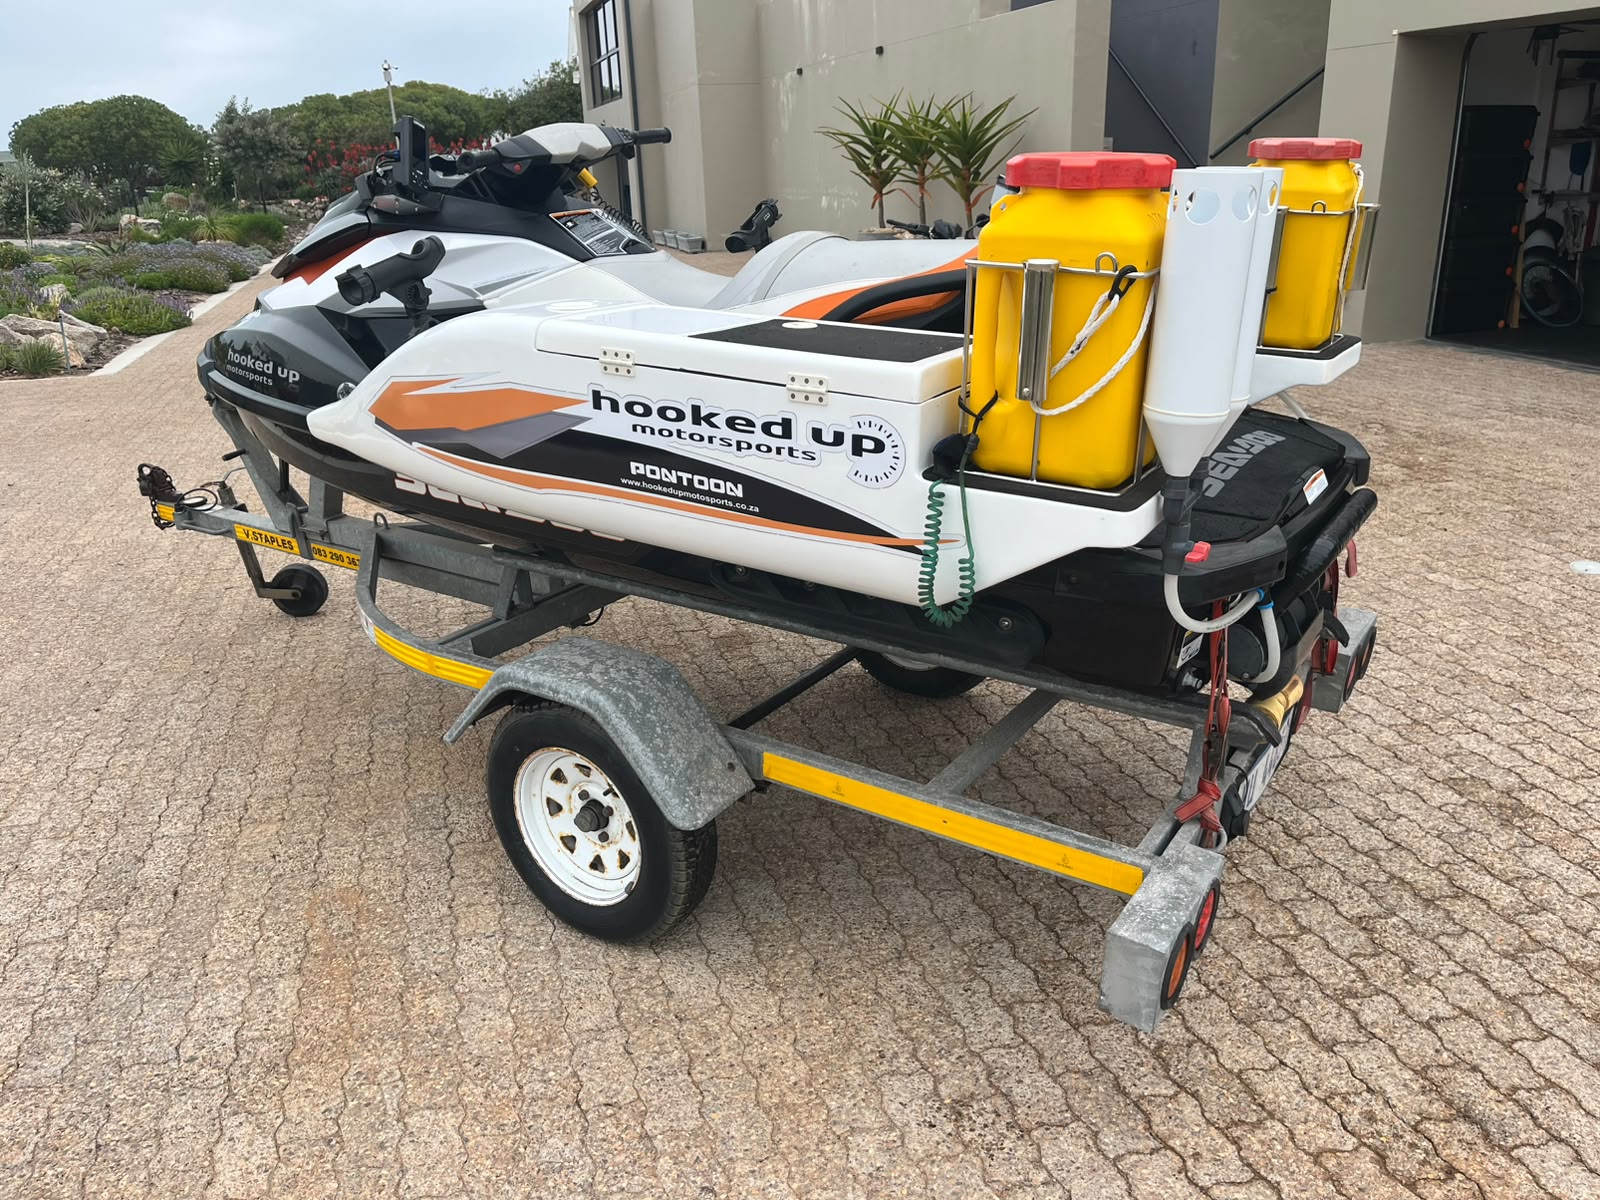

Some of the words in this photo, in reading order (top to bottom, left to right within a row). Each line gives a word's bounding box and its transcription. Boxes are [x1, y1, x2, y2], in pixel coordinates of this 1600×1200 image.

[226, 364, 273, 386] motorsports
[227, 348, 273, 374] hooked
[277, 366, 300, 383] up
[592, 389, 793, 440] hooked
[811, 426, 887, 458] up
[631, 422, 817, 462] motorsports
[620, 477, 760, 513] www.hookedupmotosports.co.za
[630, 461, 743, 498] PONTOON
[243, 528, 294, 551] V.STAPLES
[312, 546, 328, 558] 083
